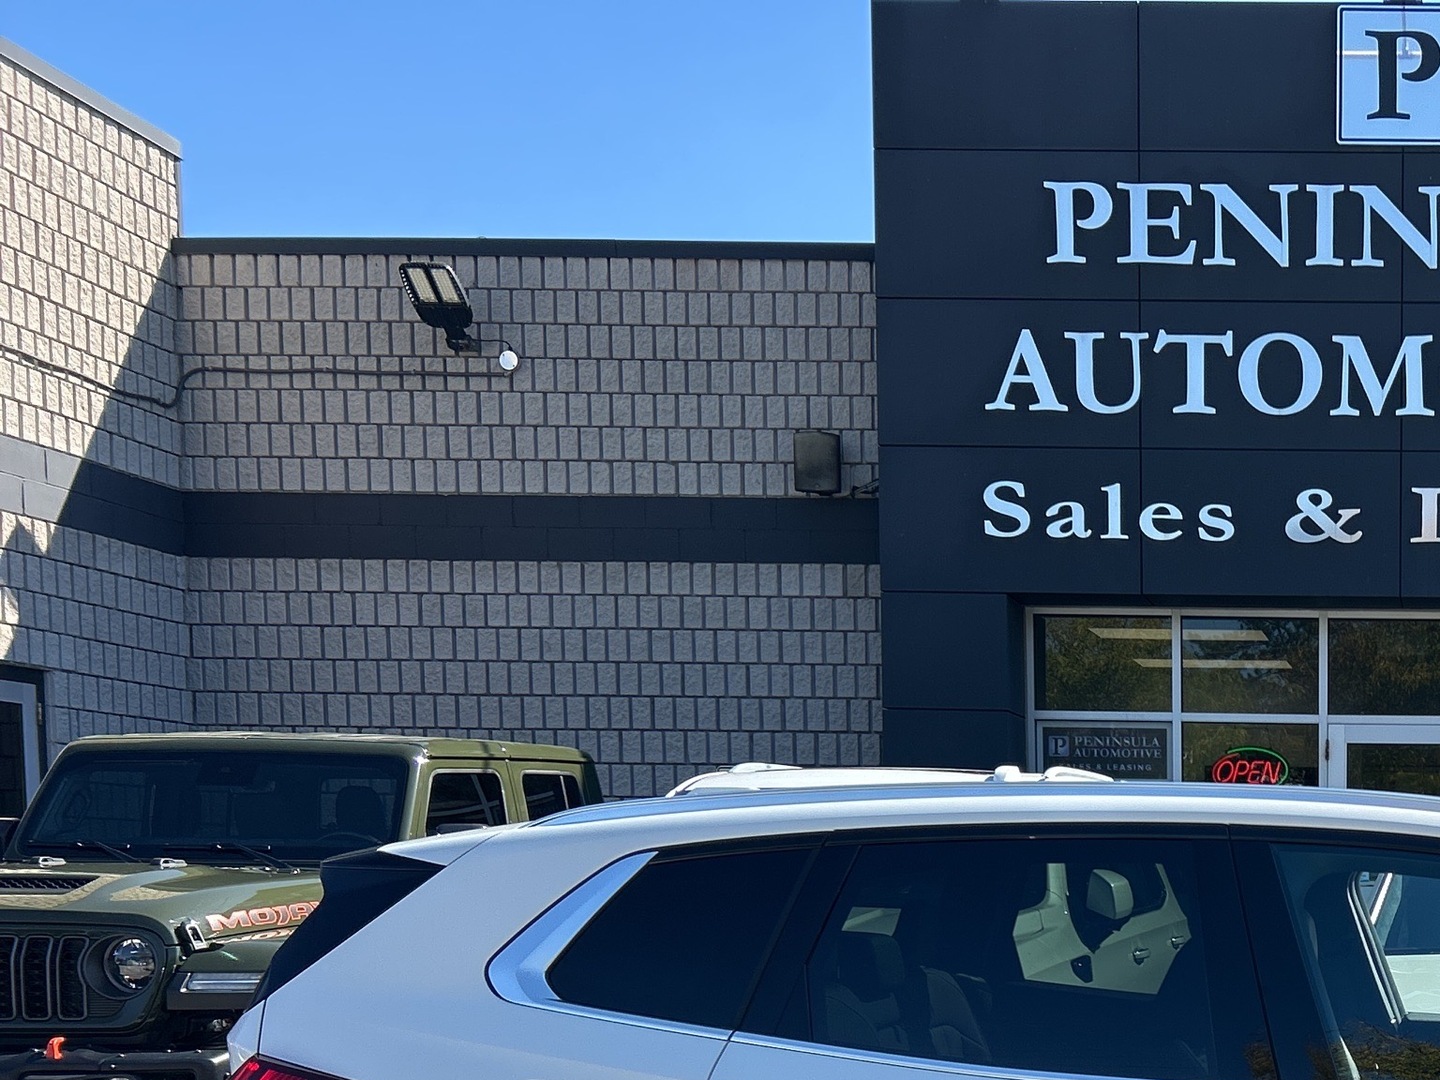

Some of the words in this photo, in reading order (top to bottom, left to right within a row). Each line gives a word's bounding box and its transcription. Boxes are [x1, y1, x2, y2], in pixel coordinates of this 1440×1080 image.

[982, 480, 1235, 542] Sales
[1284, 488, 1363, 544] &
[1073, 735, 1161, 748] PENINSULA
[1073, 748, 1162, 759] AUTOMOTIVE
[1106, 762, 1153, 772] LEASING
[1216, 760, 1282, 784] OPEN
